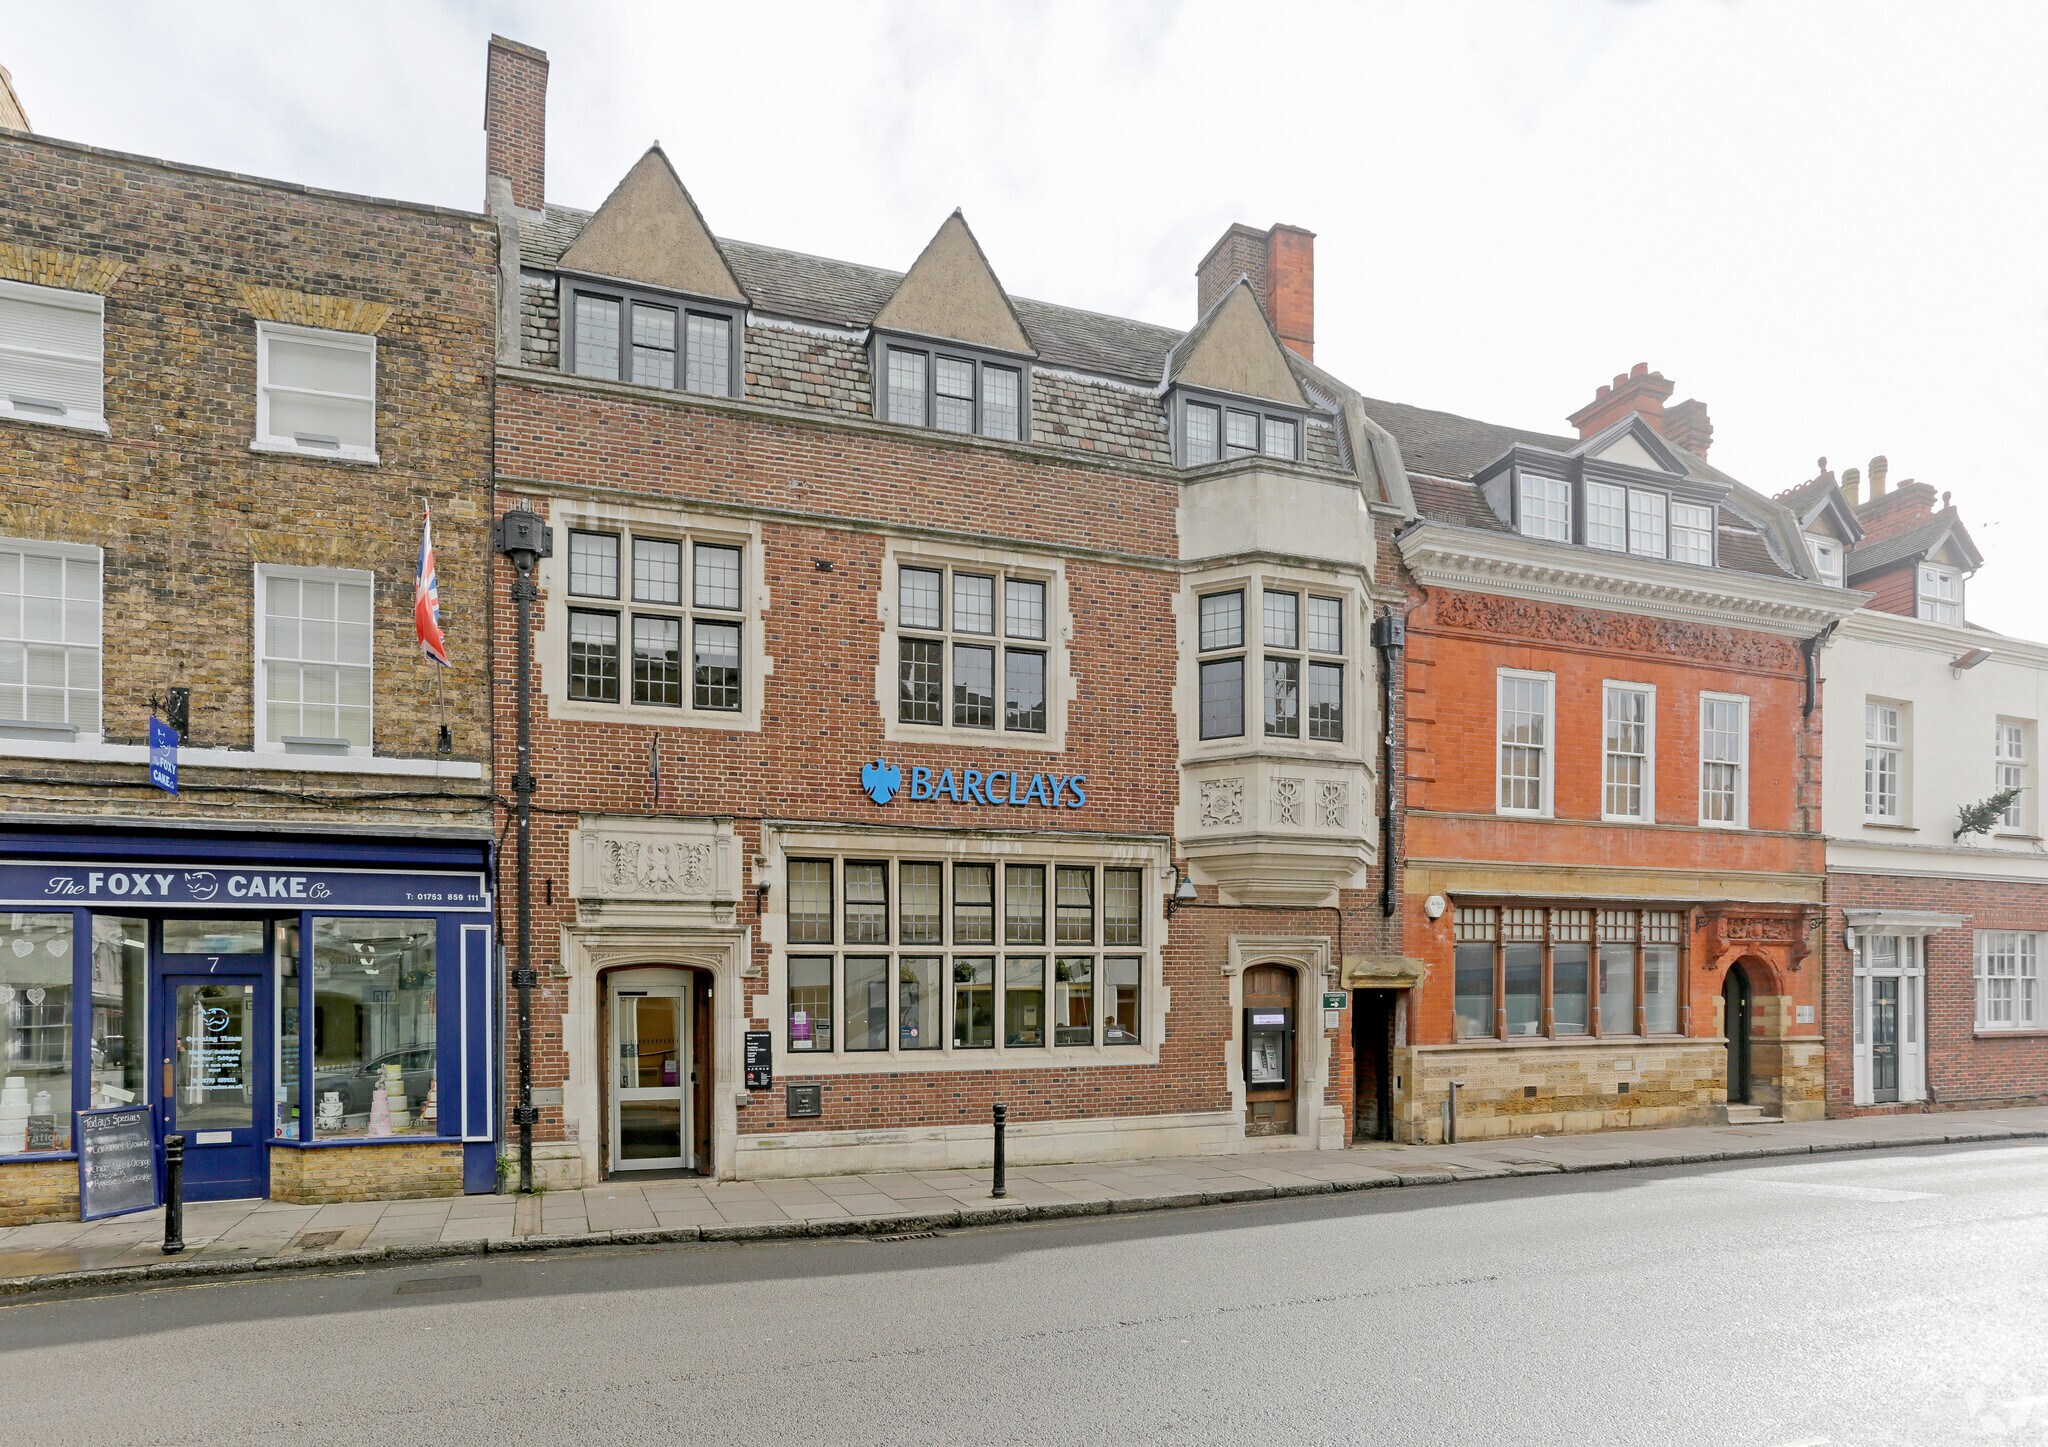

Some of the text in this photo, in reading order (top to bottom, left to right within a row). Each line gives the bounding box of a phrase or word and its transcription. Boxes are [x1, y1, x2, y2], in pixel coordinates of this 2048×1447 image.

[160, 757, 177, 775] FOXY
[153, 769, 170, 788] CAKE
[910, 766, 1087, 809] BARCLAYS
[44, 872, 333, 899] The FOXY CAKE Co
[417, 893, 443, 901] 01753
[207, 957, 220, 973] 7
